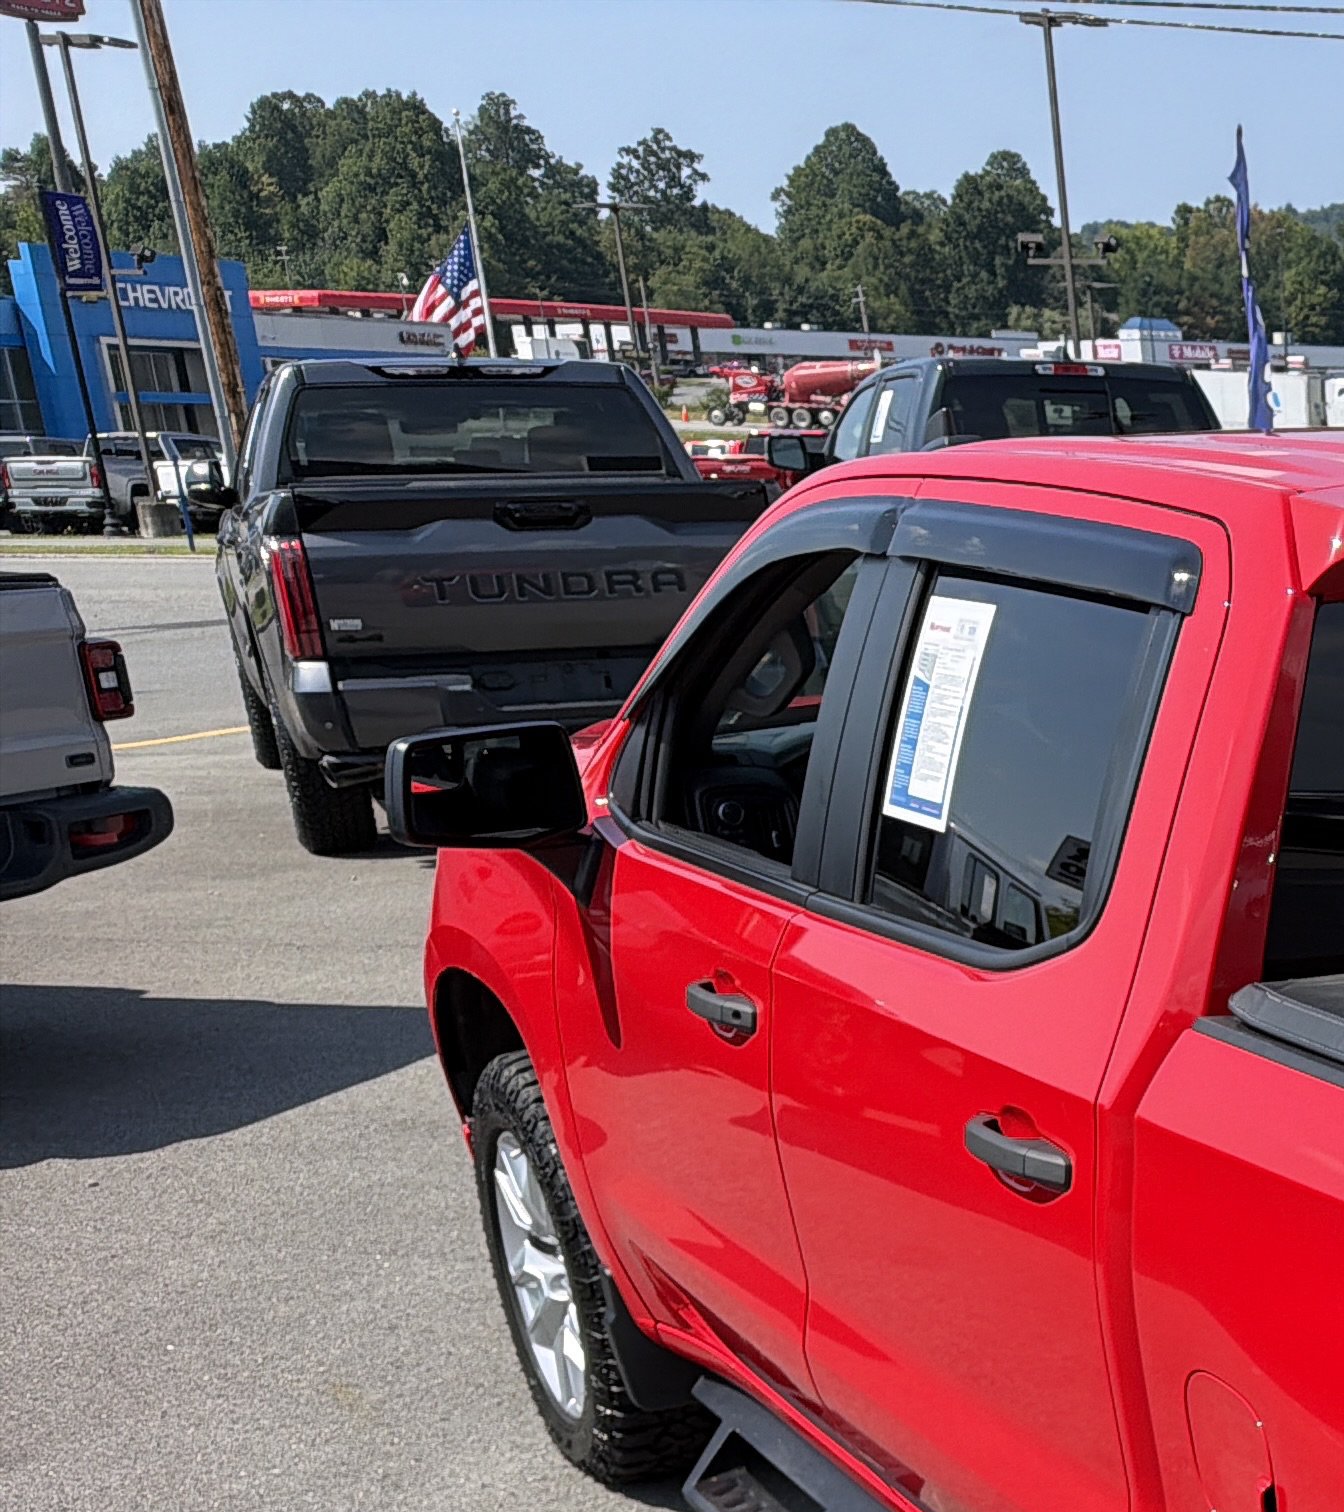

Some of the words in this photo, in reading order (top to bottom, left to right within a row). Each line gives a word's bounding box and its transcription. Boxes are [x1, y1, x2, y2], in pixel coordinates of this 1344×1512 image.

[56, 200, 82, 272] Welcome
[71, 203, 96, 274] Welcome
[115, 282, 232, 313] CHEVROT
[418, 567, 688, 604] TUNDRA
